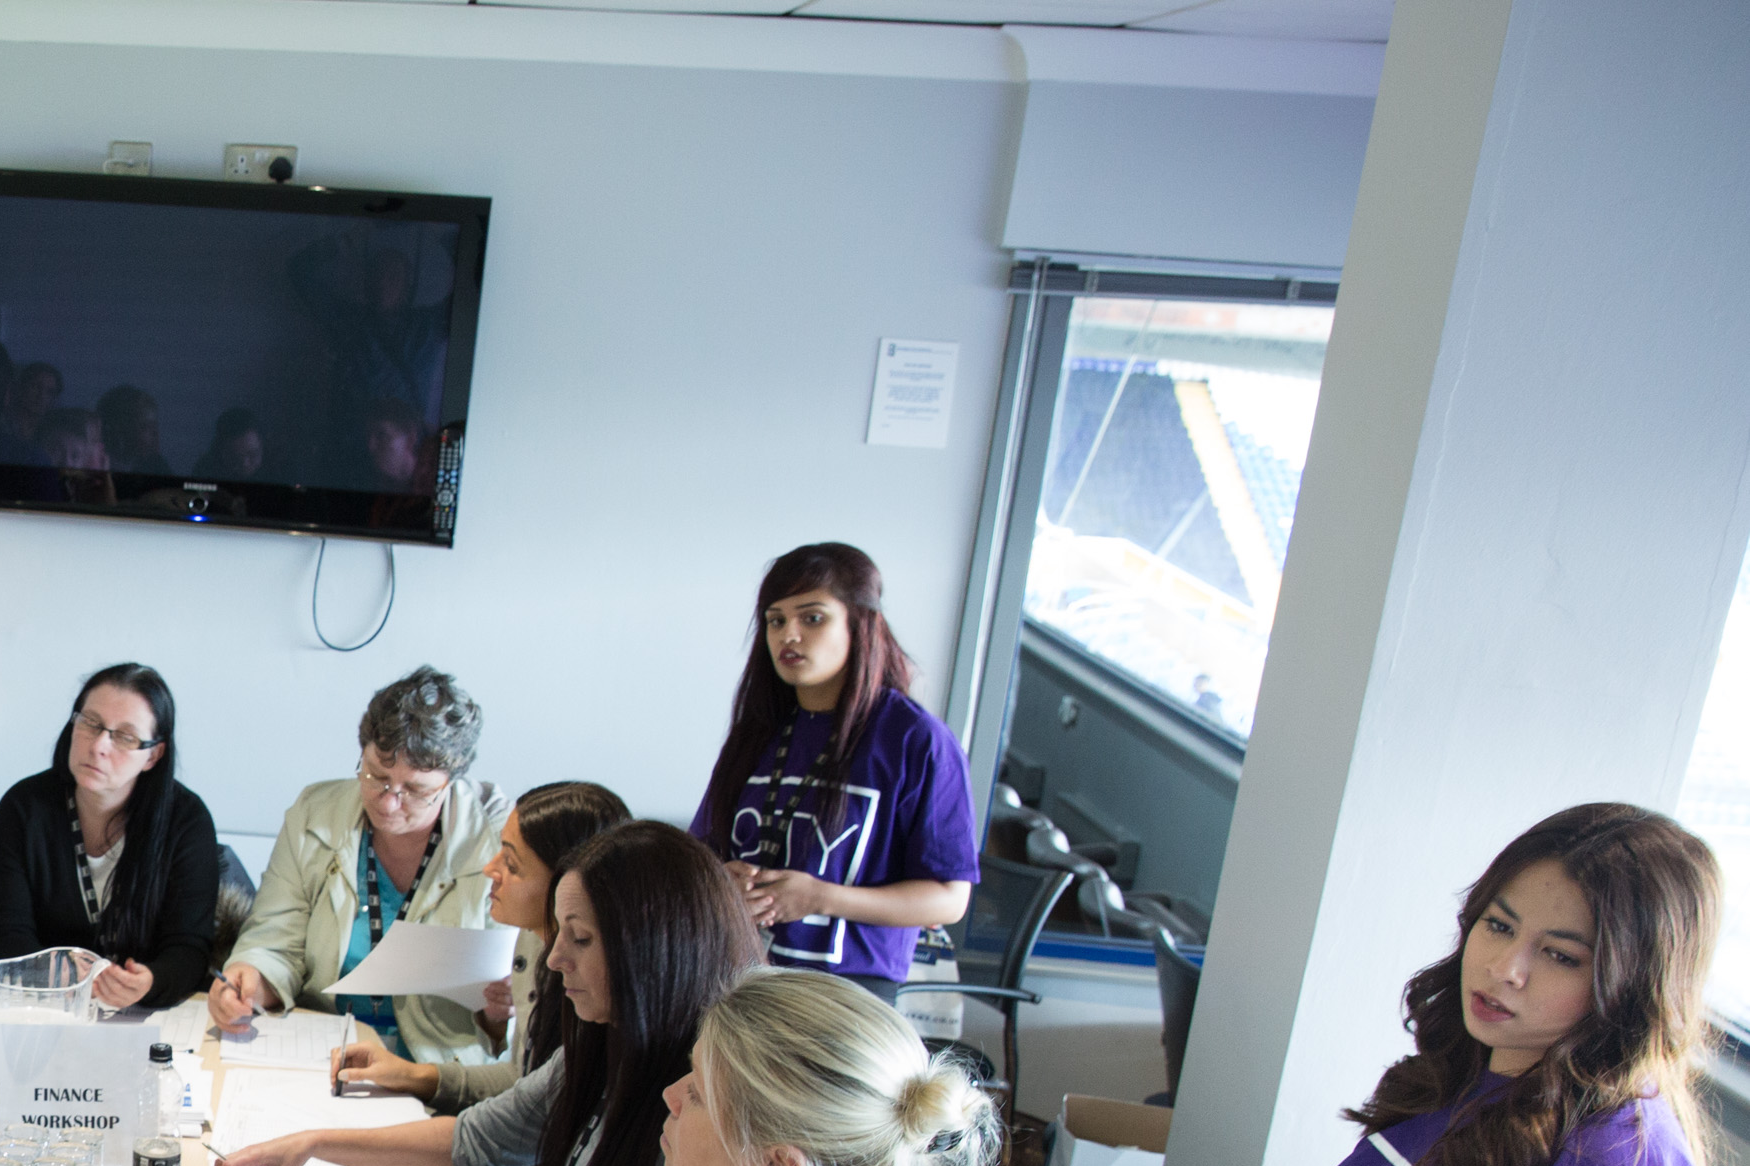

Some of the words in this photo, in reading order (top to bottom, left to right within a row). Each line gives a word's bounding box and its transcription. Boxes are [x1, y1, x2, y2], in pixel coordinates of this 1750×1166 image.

[731, 807, 859, 876] CTY
[34, 1088, 104, 1102] FINANCE
[22, 1115, 120, 1129] WORKSHOP
